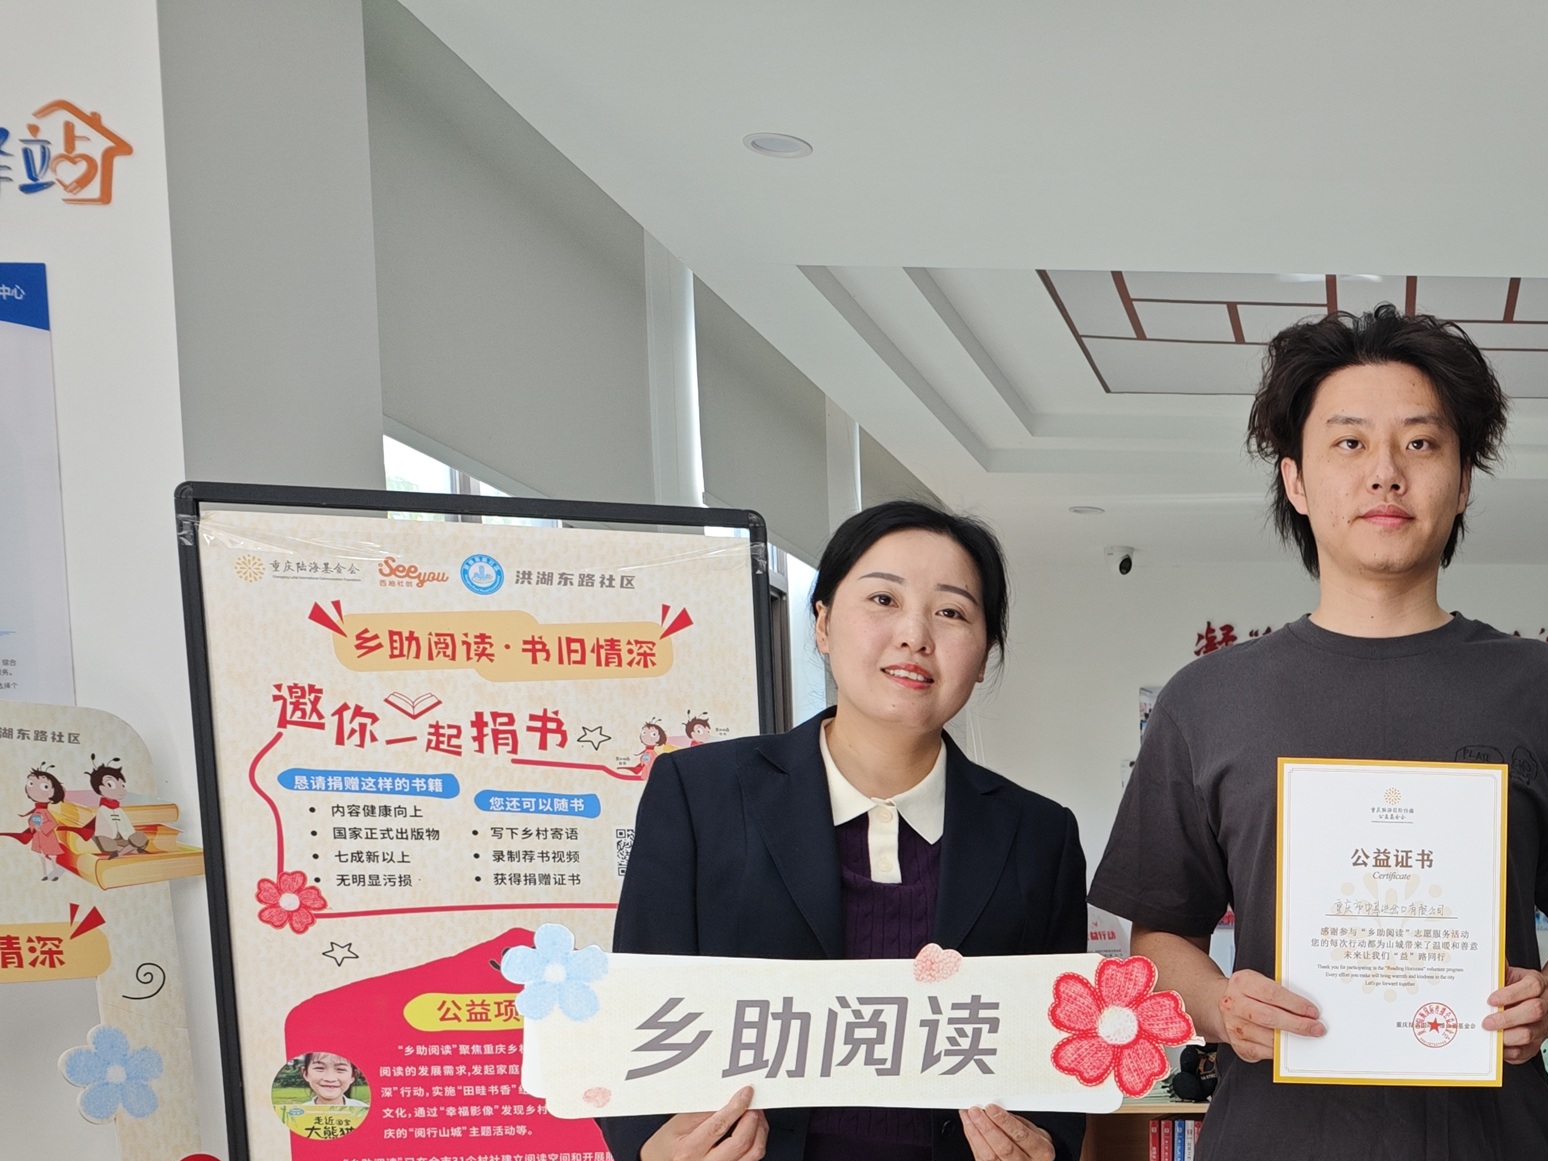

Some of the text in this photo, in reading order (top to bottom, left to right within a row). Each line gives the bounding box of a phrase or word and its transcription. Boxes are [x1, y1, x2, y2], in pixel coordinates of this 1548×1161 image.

[269, 560, 360, 575] 重庆陆海基金会
[515, 570, 636, 590] 洪湖东路社区
[353, 628, 658, 669] 乡助阅读·书旧情深
[271, 681, 570, 757] 邀你一起捐书
[292, 774, 443, 793] 恳请捐赠这样的书籍
[331, 803, 424, 819] 内容健康向上
[488, 795, 584, 814] 您还可以随书
[332, 827, 441, 842] 国家正式出版物
[490, 827, 580, 841] 写下乡村寄语
[334, 851, 411, 865] 七成新以上
[491, 850, 581, 865] 录制荐书视频
[1350, 848, 1434, 869] 公益证书
[335, 873, 413, 888] 无明显污损
[492, 872, 582, 887] 获得捐赠证书
[1372, 871, 1411, 881] Certificate
[1320, 928, 1470, 939] 感谢参与“乡助阅读”志愿服务活动
[1311, 938, 1479, 951] 您的每次行动都为山城带来了温暖和善意
[1344, 951, 1446, 962] 未来让我们“益”路同行
[624, 993, 1000, 1082] 乡助阅读
